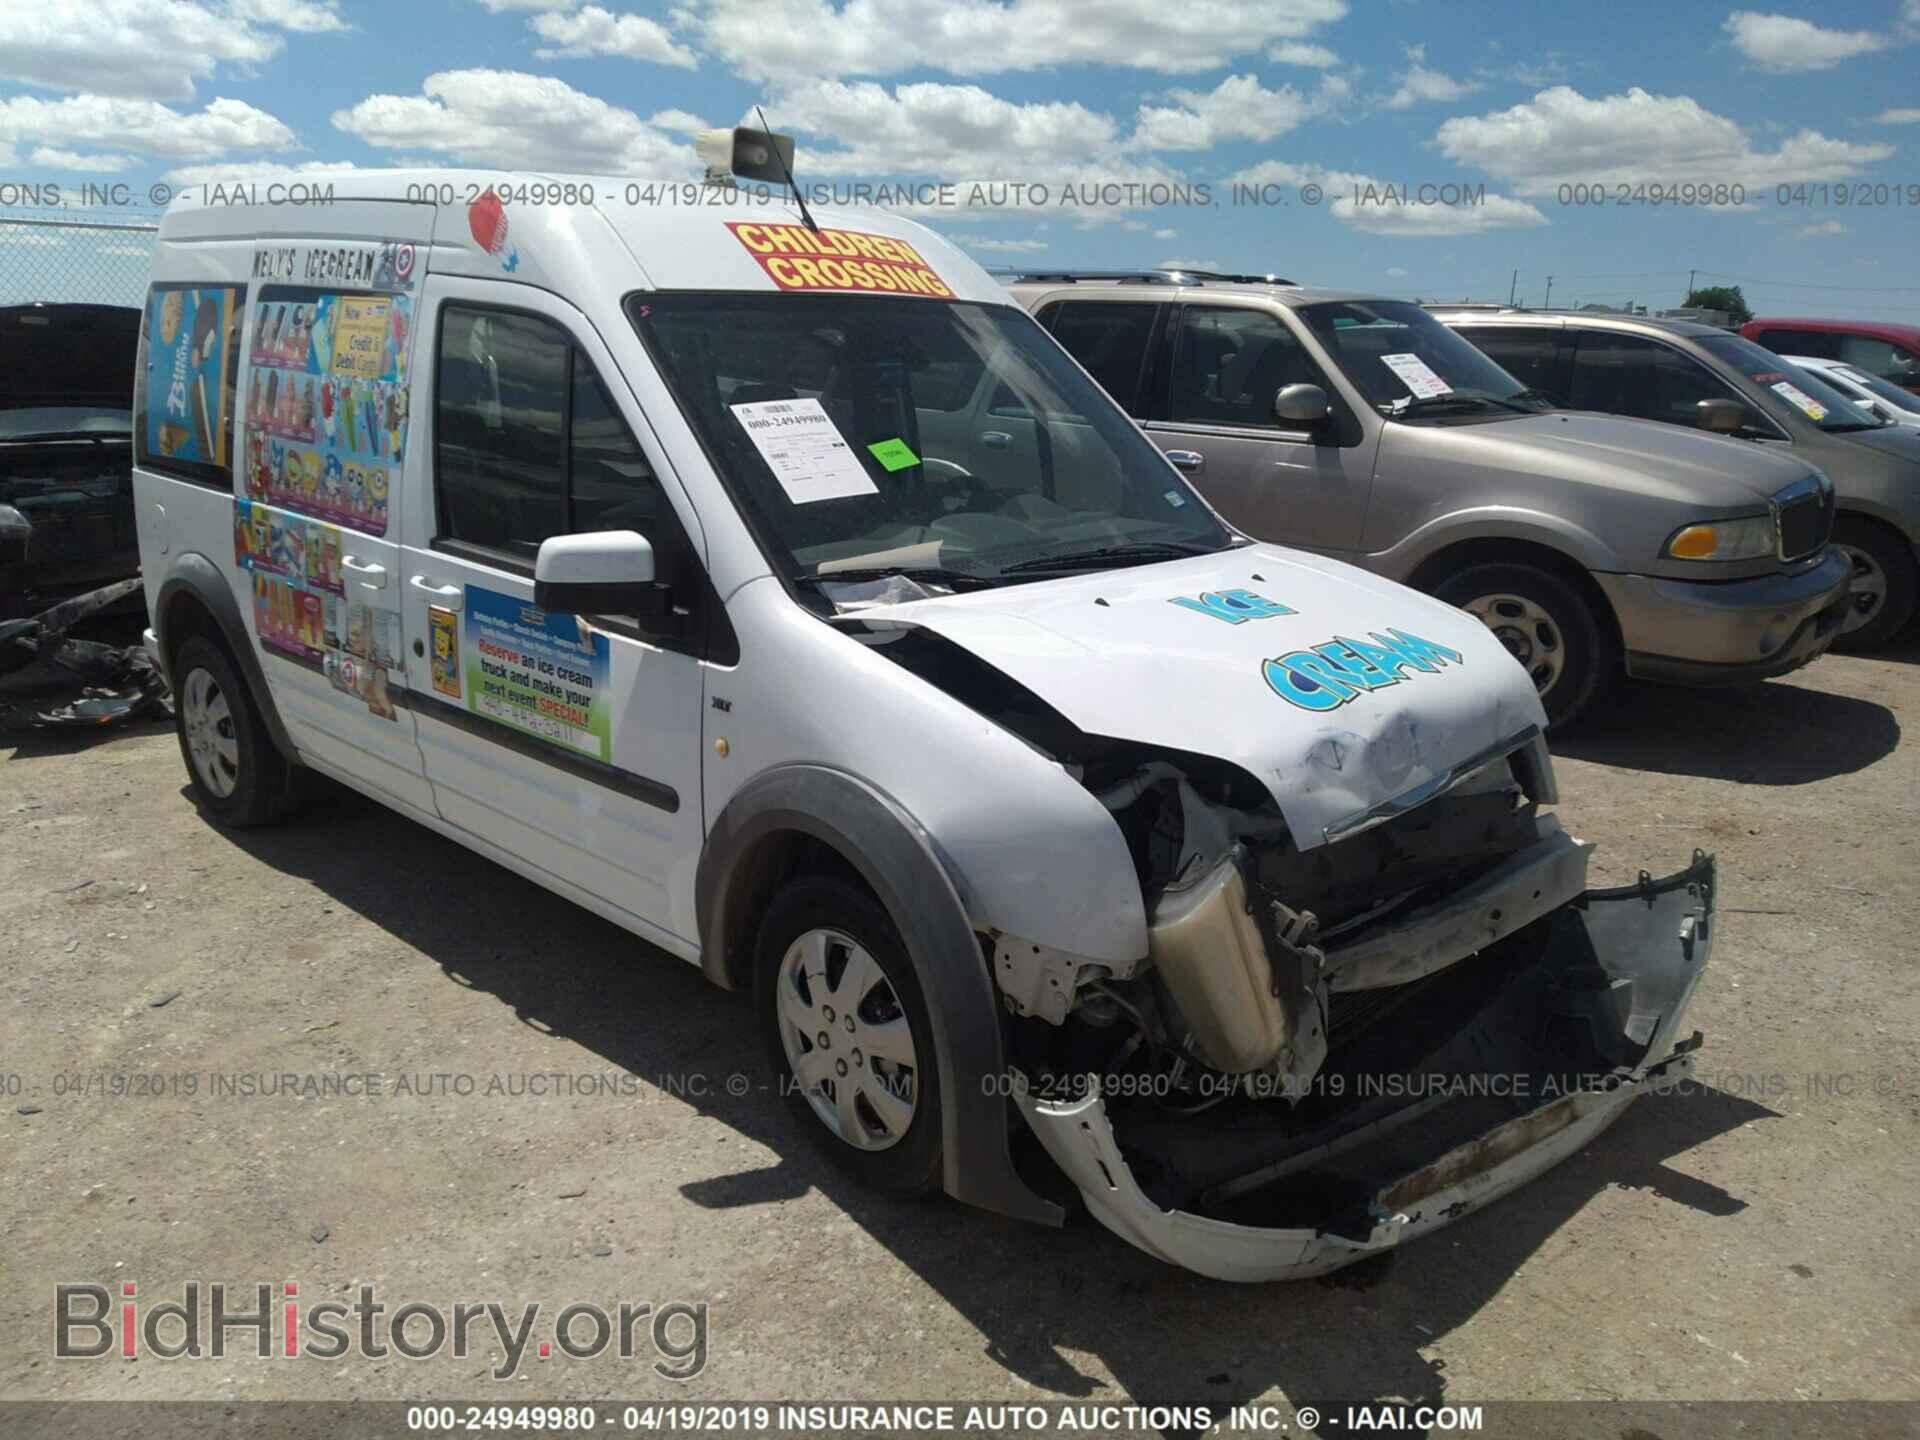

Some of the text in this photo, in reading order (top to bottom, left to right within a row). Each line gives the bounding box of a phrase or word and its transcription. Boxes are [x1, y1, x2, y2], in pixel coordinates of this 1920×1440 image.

[735, 224, 926, 267] CHILDREN
[766, 257, 951, 297] CROSSING
[335, 352, 355, 369] Debit
[349, 334, 372, 352] Credit
[748, 414, 826, 429] 000-24949980
[1166, 588, 1300, 625] ICE
[478, 638, 520, 664] Reserve
[521, 655, 535, 669] an
[538, 656, 555, 675] ice
[557, 666, 592, 689] cream
[481, 657, 592, 708] truck and make your
[1261, 627, 1464, 712] CREAM
[484, 680, 589, 728] next event SPECIAL!
